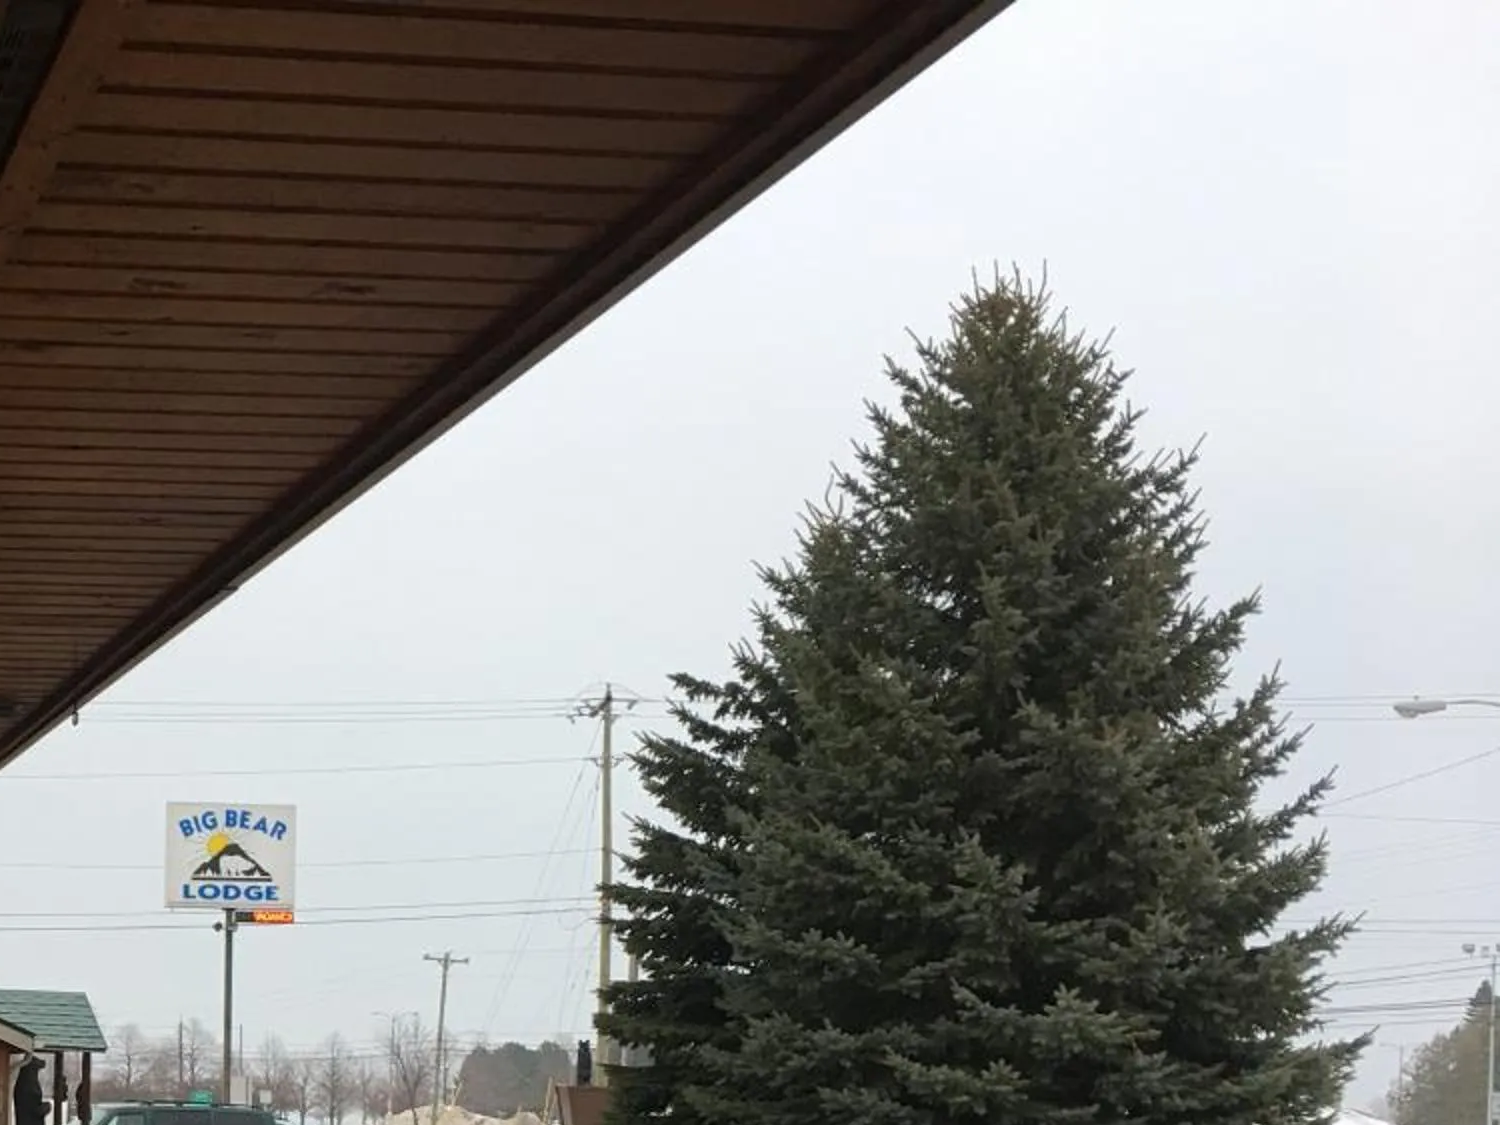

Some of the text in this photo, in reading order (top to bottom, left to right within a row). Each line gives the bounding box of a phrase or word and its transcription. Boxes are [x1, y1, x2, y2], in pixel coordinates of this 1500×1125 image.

[179, 809, 287, 840] BIG BEAR
[182, 883, 279, 901] LODGE
